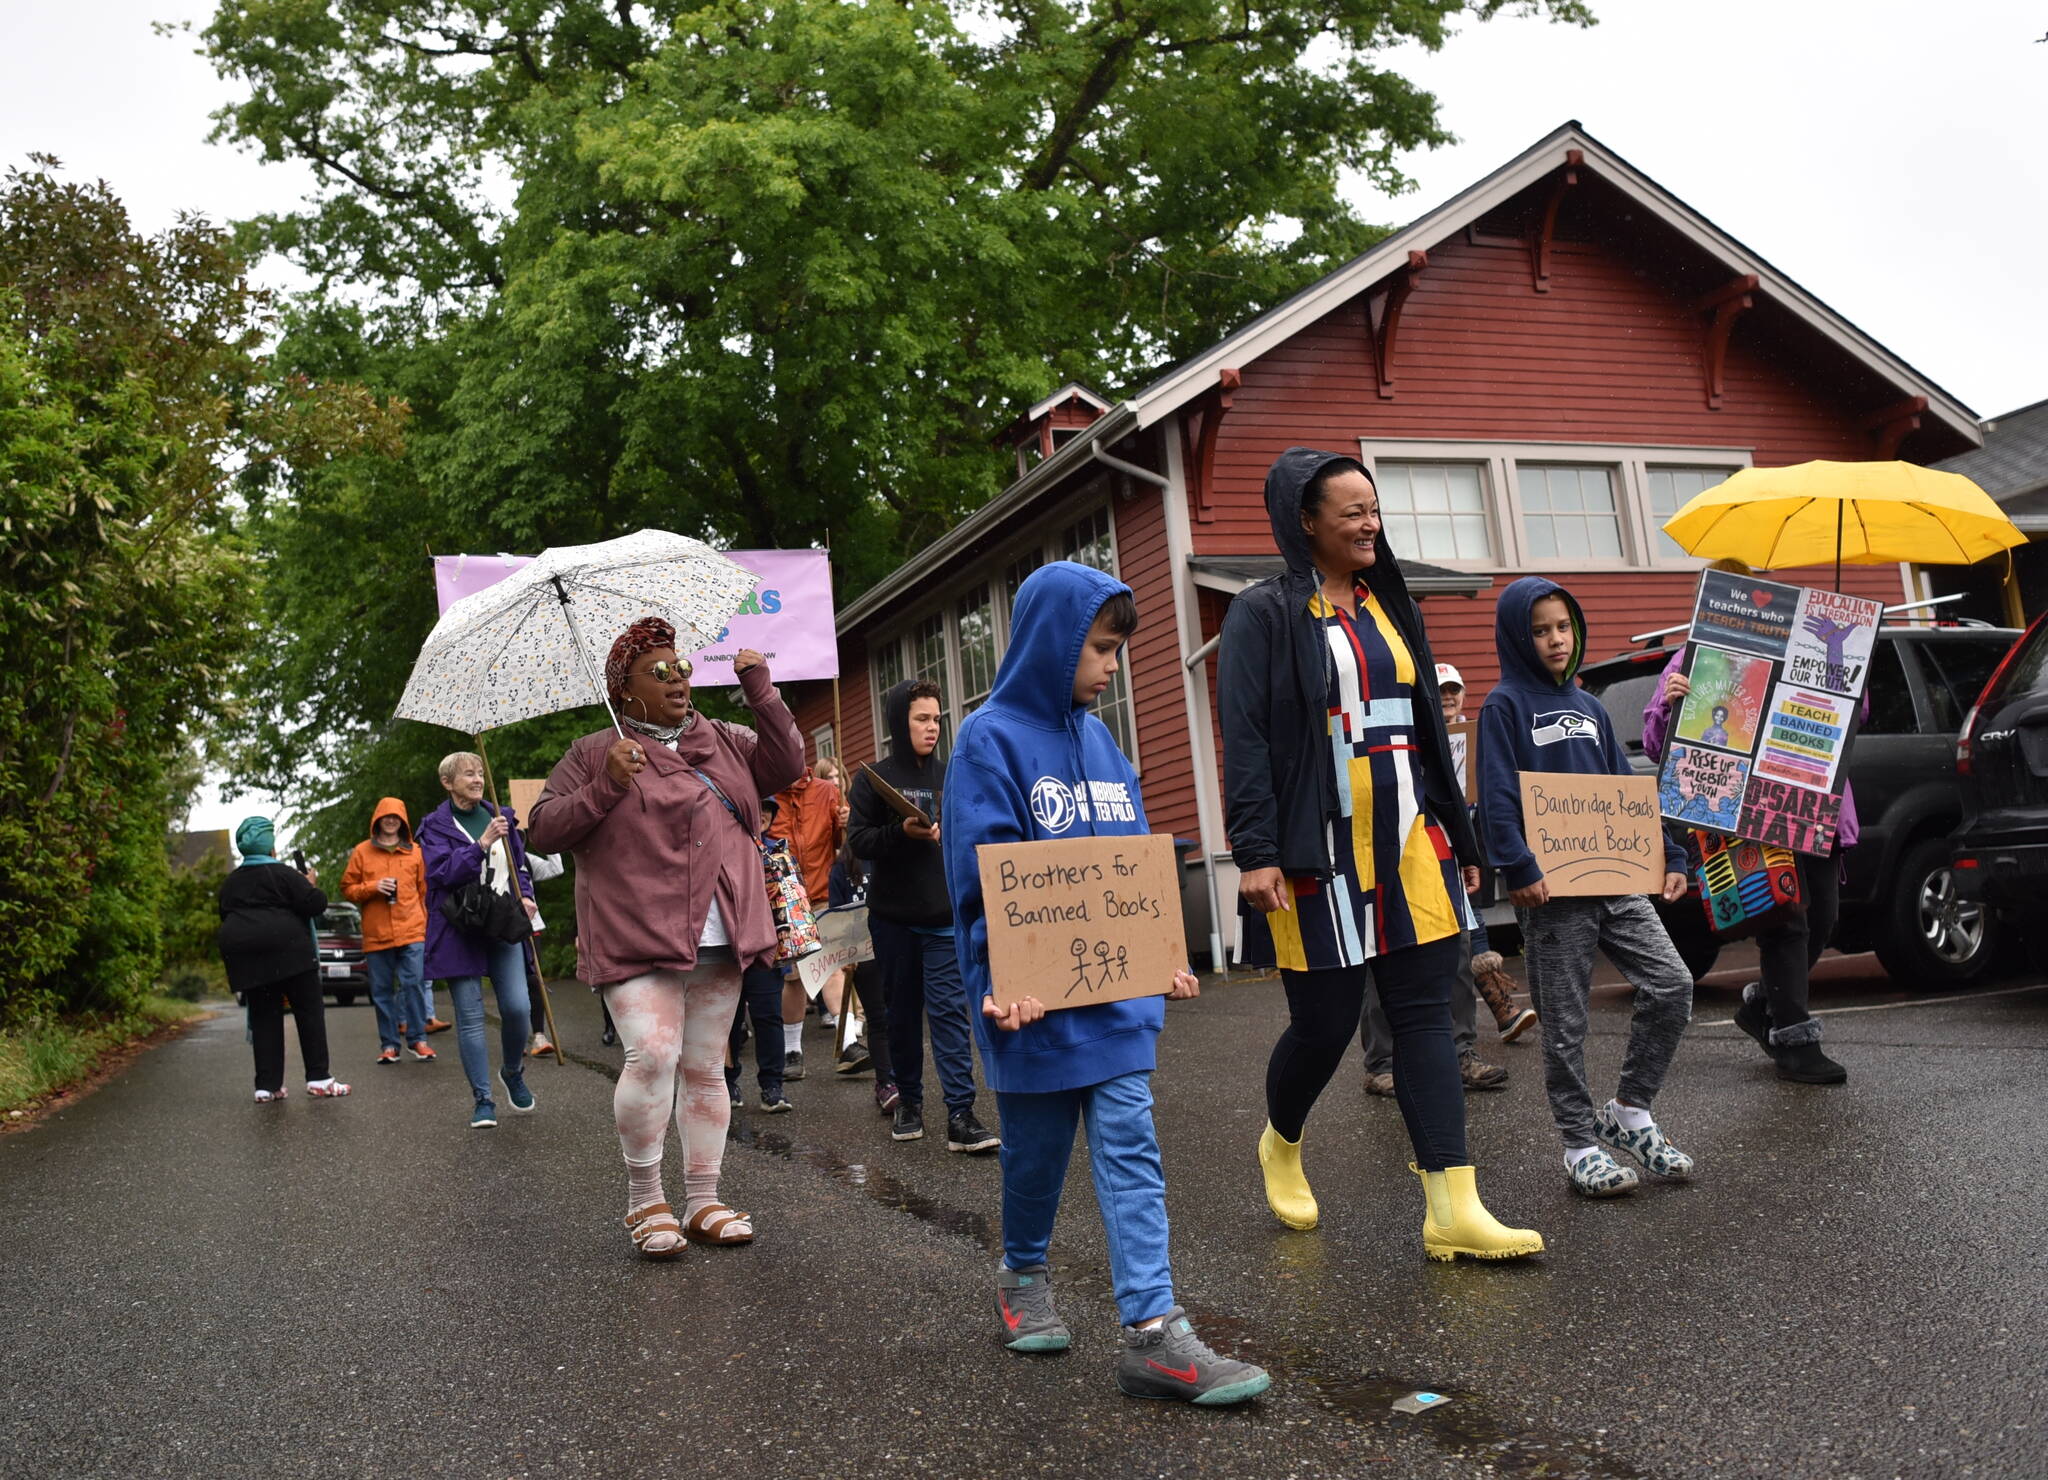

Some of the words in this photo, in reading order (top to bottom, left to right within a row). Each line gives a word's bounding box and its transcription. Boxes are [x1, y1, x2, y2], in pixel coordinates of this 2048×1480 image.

[1730, 588, 1748, 601] We
[1808, 590, 1877, 616] EDUCATION
[1709, 599, 1758, 618] teachers
[1760, 611, 1785, 623] who
[1804, 604, 1816, 616] IS
[1818, 606, 1874, 628] LIBERATION
[1750, 622, 1791, 639] TRUTH
[1789, 669, 1811, 684] OUR
[1793, 655, 1851, 679] EMPOWER
[1789, 704, 1832, 723] TEACH
[1780, 716, 1833, 737] BANNED
[1780, 730, 1825, 750] BOOKS
[1682, 767, 1695, 777] FOR
[1688, 749, 1718, 770] RISE
[1720, 759, 1735, 772] UP
[1073, 780, 1131, 803] BANBRIDGE
[1690, 781, 1718, 798] YOUTH
[1077, 802, 1113, 822] WTER
[1111, 804, 1136, 821] POLO
[1530, 784, 1616, 824] Bainbridge
[1617, 789, 1654, 819] Reads
[1538, 827, 1599, 854] Banned
[1604, 825, 1651, 856] Books
[1736, 806, 1837, 855] HATE
[1000, 860, 1103, 892] Brothers
[1004, 901, 1091, 927] Banned
